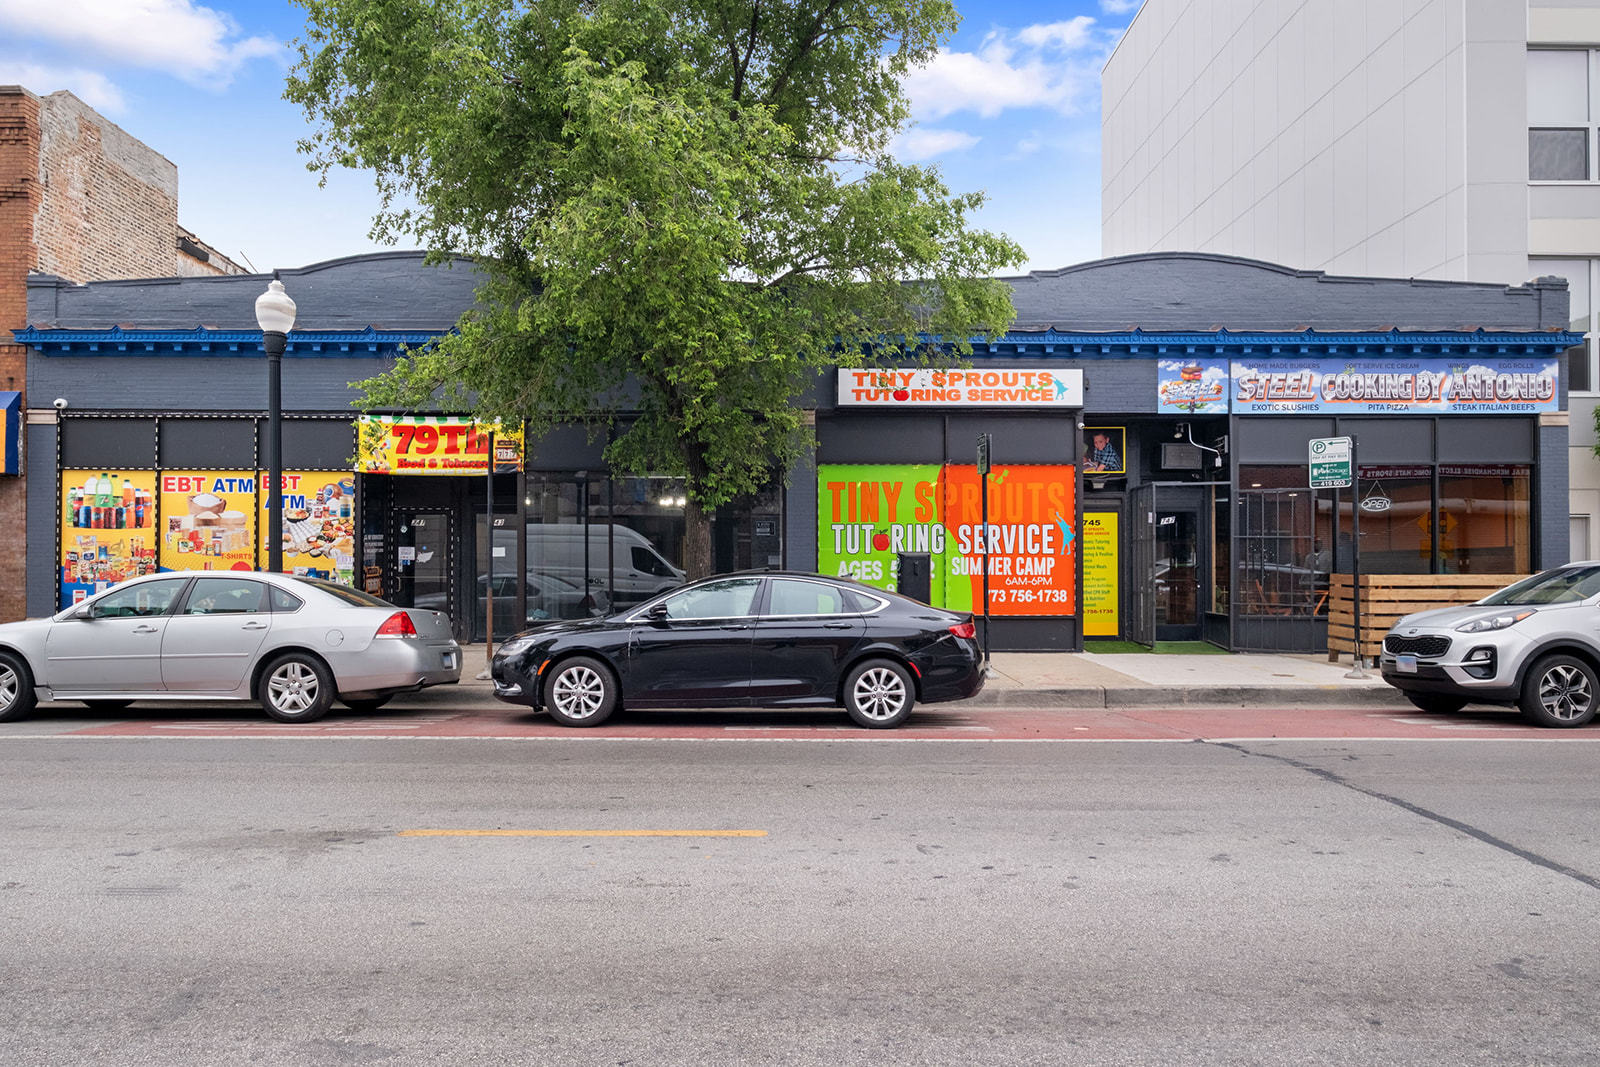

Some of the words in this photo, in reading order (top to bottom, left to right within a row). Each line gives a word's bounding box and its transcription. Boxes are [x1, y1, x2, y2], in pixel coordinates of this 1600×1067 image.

[852, 372, 915, 387] TINY
[931, 371, 1053, 387] SPROUTS
[967, 388, 1054, 401] SERVICE
[1237, 373, 1316, 401] STEEL
[1320, 373, 1413, 402] COOKING
[1415, 373, 1445, 402] BY
[1448, 373, 1554, 402] ANTONIO
[428, 458, 438, 469] &
[441, 458, 488, 469] Tobacc
[163, 477, 206, 492] EBT
[212, 478, 253, 493] ATM
[827, 481, 903, 523] TINY
[915, 481, 1065, 523] SPROUTS
[1362, 499, 1391, 509] OPEN
[958, 523, 1055, 555] SERVICE
[837, 560, 883, 580] AGES
[951, 556, 1012, 576] SUMMER
[1015, 556, 1055, 576] CAMP
[1005, 576, 1053, 586] 6AM-6PM
[988, 589, 1006, 602] 73
[1009, 589, 1068, 602] 756-1738
